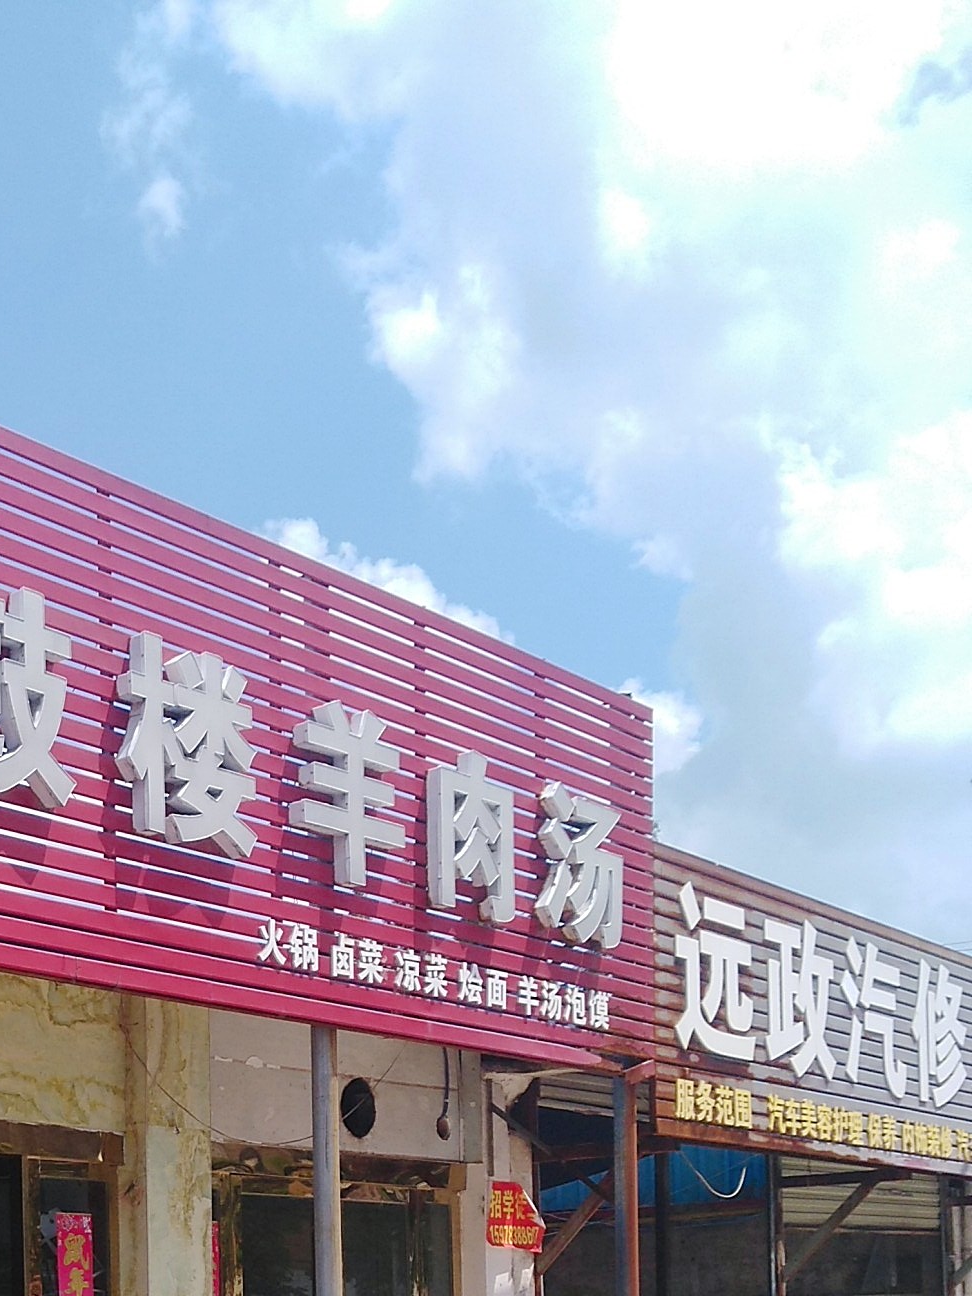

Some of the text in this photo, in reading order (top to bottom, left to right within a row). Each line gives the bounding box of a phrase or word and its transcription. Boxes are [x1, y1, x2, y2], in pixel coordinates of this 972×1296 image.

[257, 918, 612, 1030] 火锅 卤菜 凉菜 烩面 羊汤泡馍
[674, 881, 966, 1108] 远政汽修
[675, 1078, 753, 1129] 服务范围
[766, 1094, 865, 1146] 汽车美容护理
[867, 1112, 897, 1150] 保养
[956, 1128, 972, 1162] 汽
